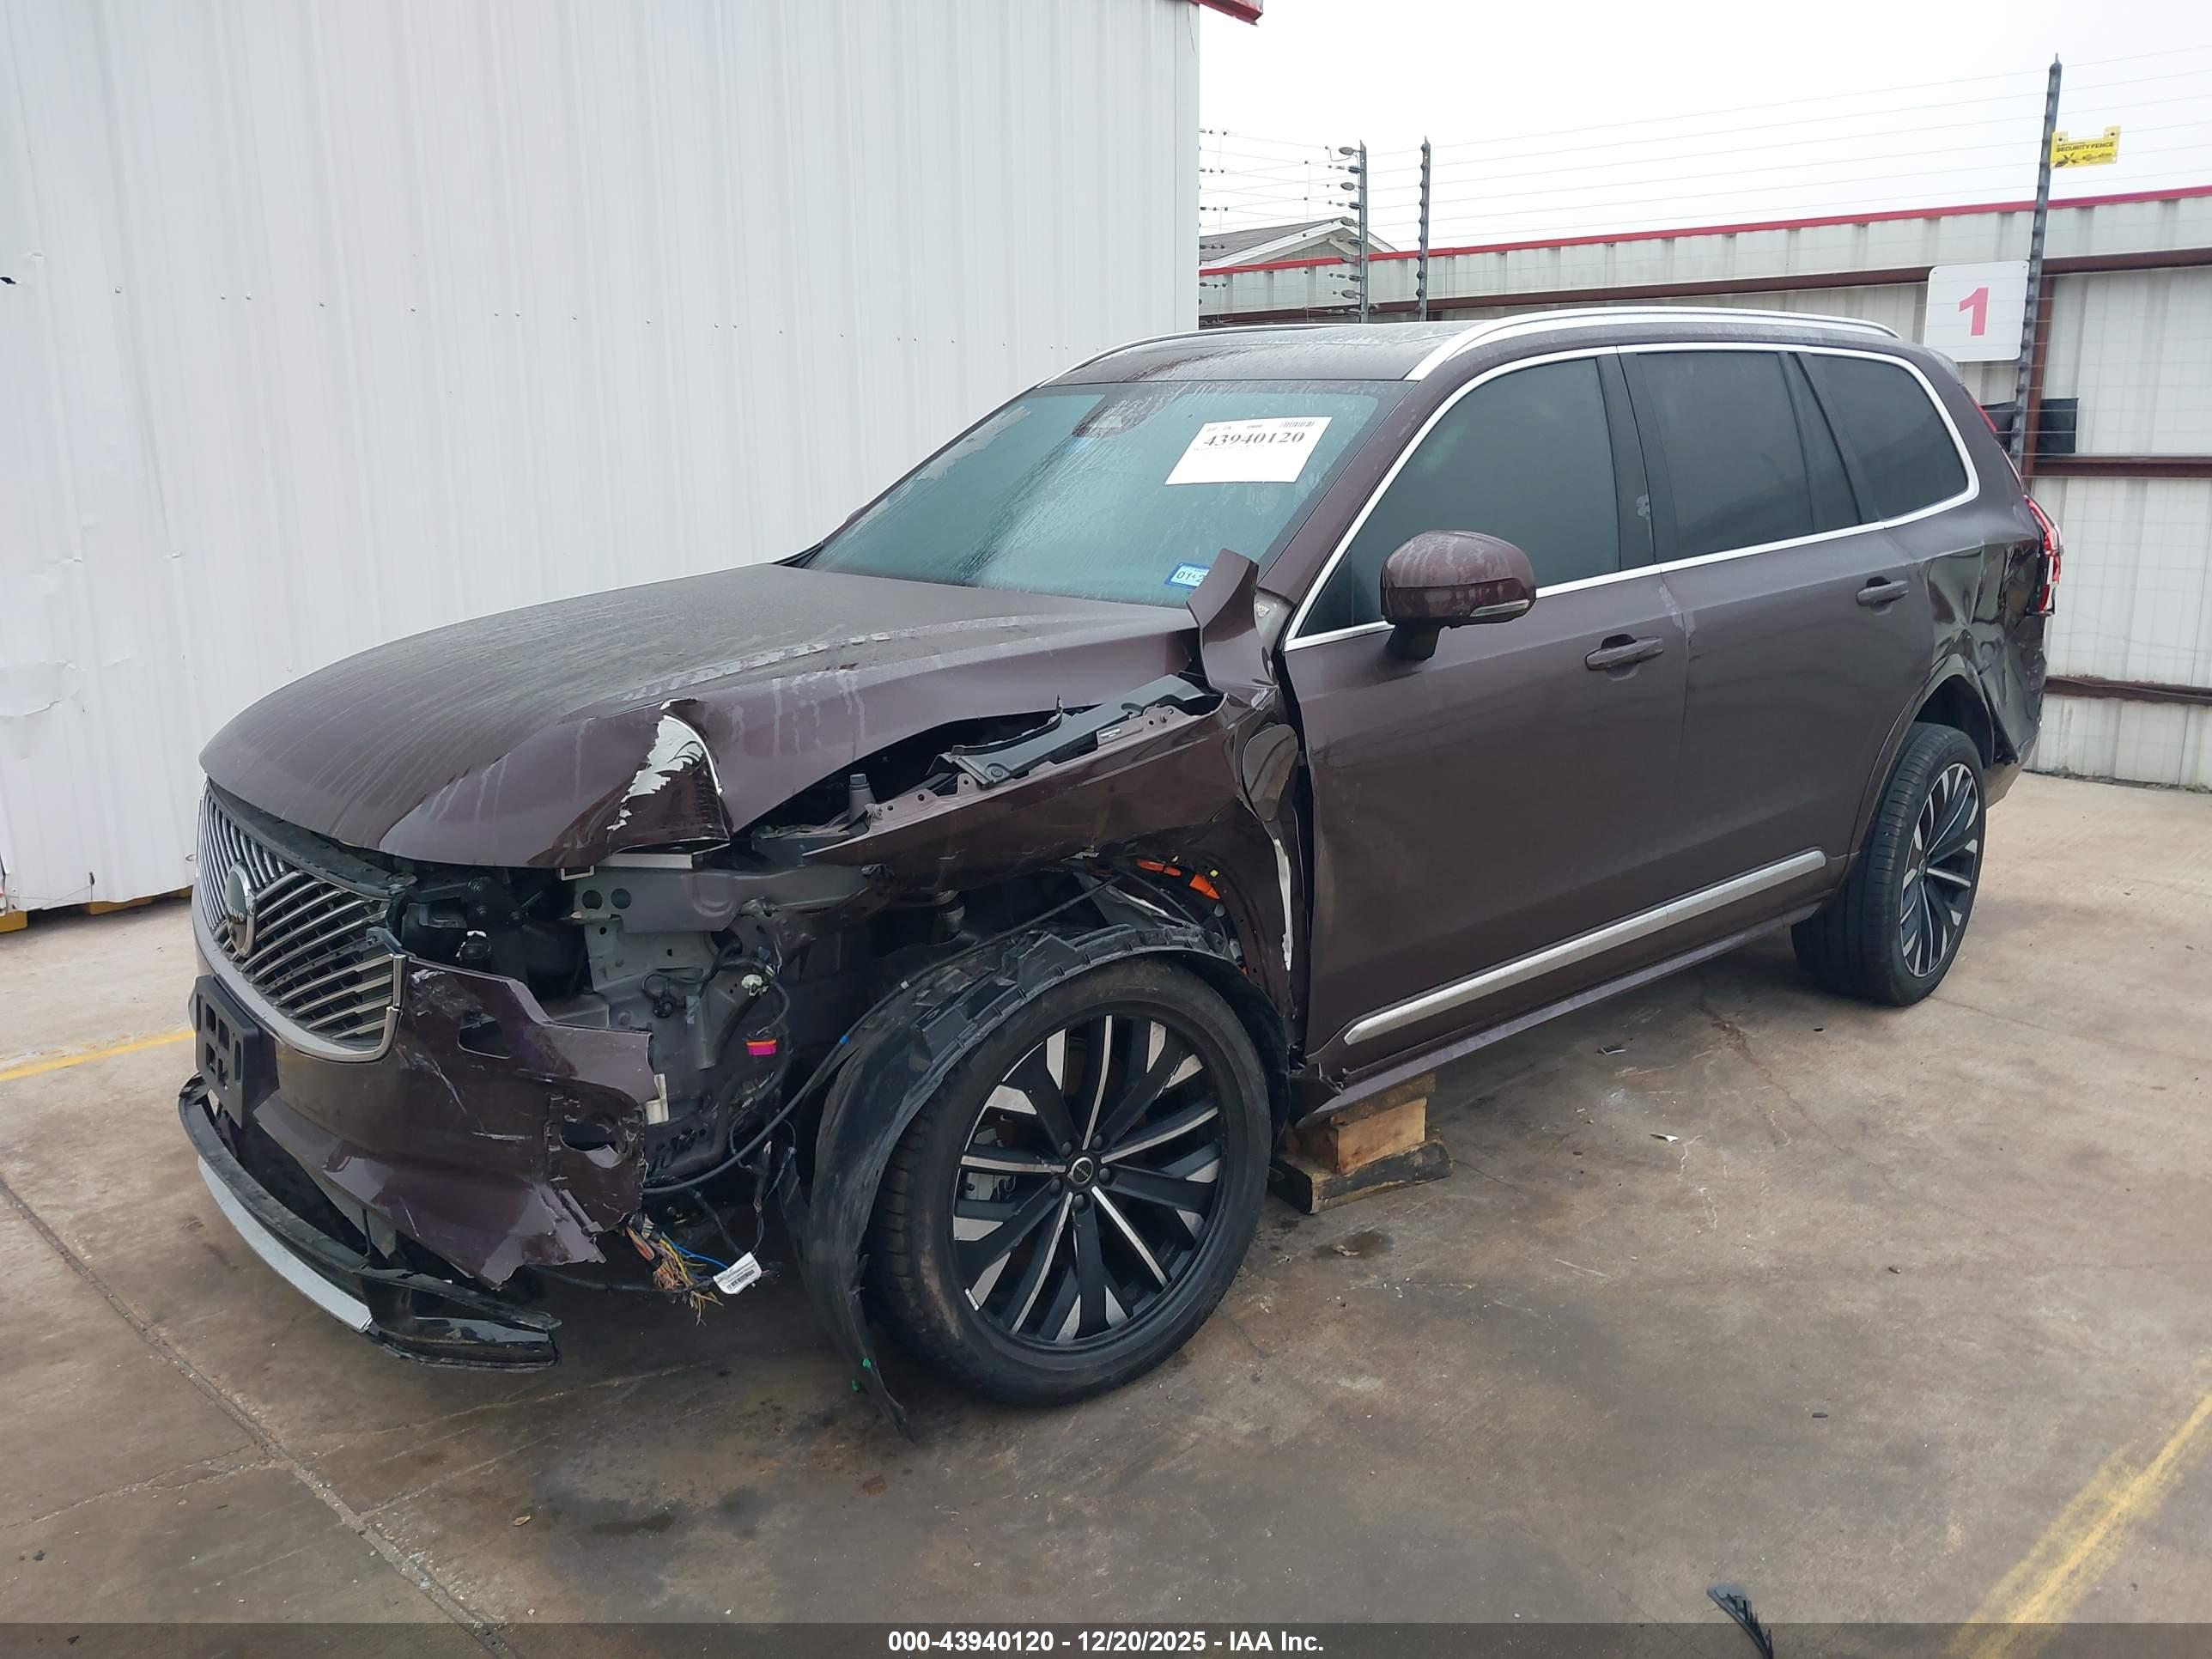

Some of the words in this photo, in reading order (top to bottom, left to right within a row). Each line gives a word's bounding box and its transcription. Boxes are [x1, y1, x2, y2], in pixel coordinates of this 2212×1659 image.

[2091, 141, 2114, 149] FENCE
[1958, 287, 1989, 337] 1
[1203, 431, 1305, 447] 43940120
[1176, 570, 1206, 583] 01-2
